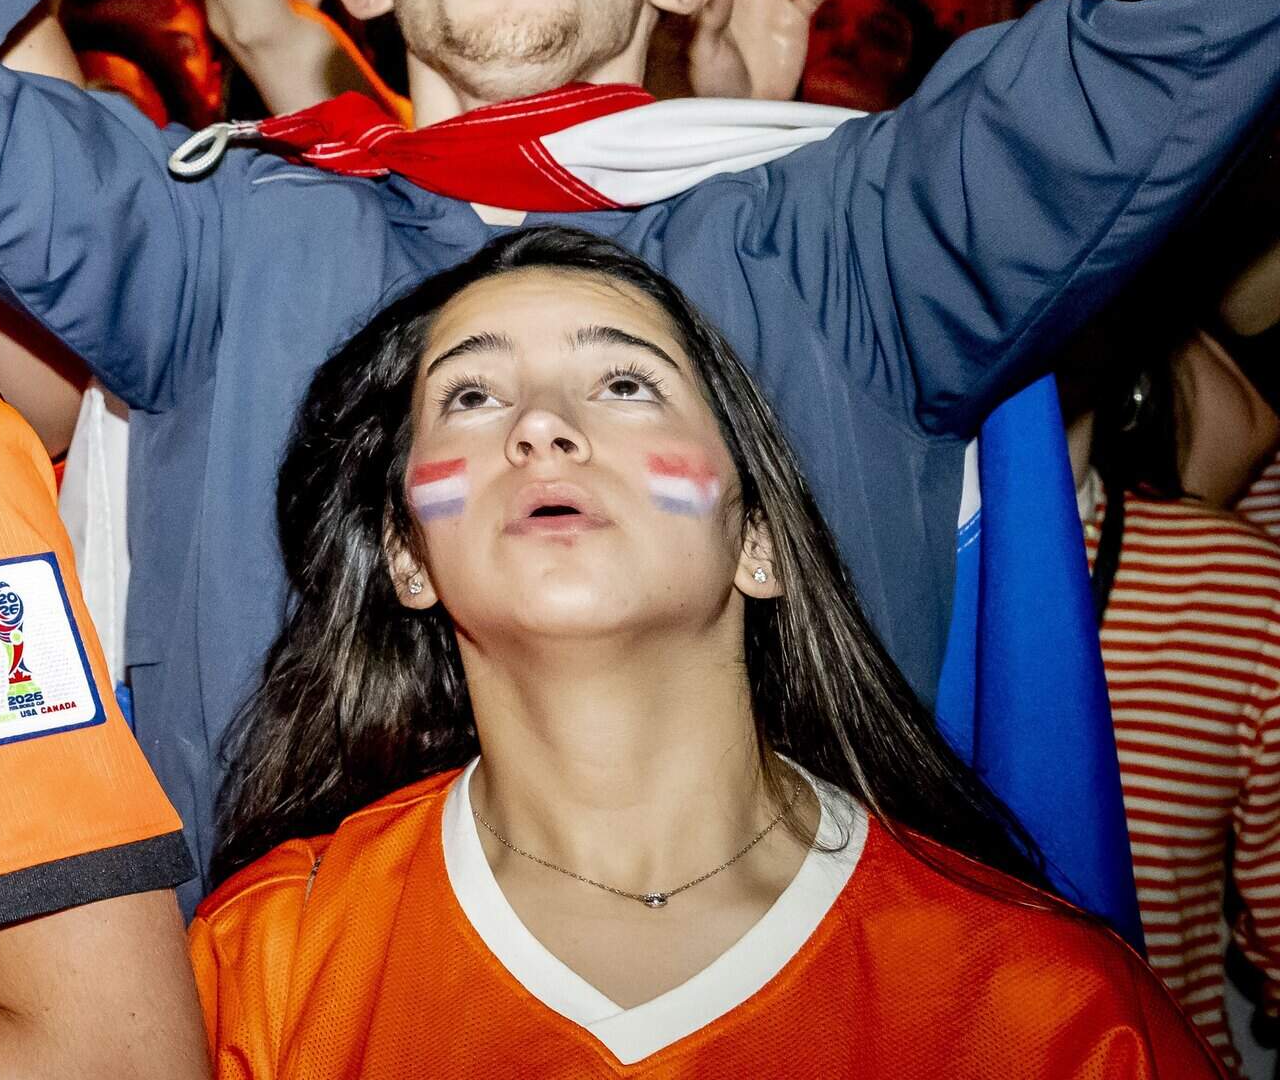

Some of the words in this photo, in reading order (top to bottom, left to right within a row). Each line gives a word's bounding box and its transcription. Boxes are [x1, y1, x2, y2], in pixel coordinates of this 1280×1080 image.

[7, 690, 44, 706] 2026
[20, 708, 38, 718] USA
[40, 700, 77, 714] CANADA
